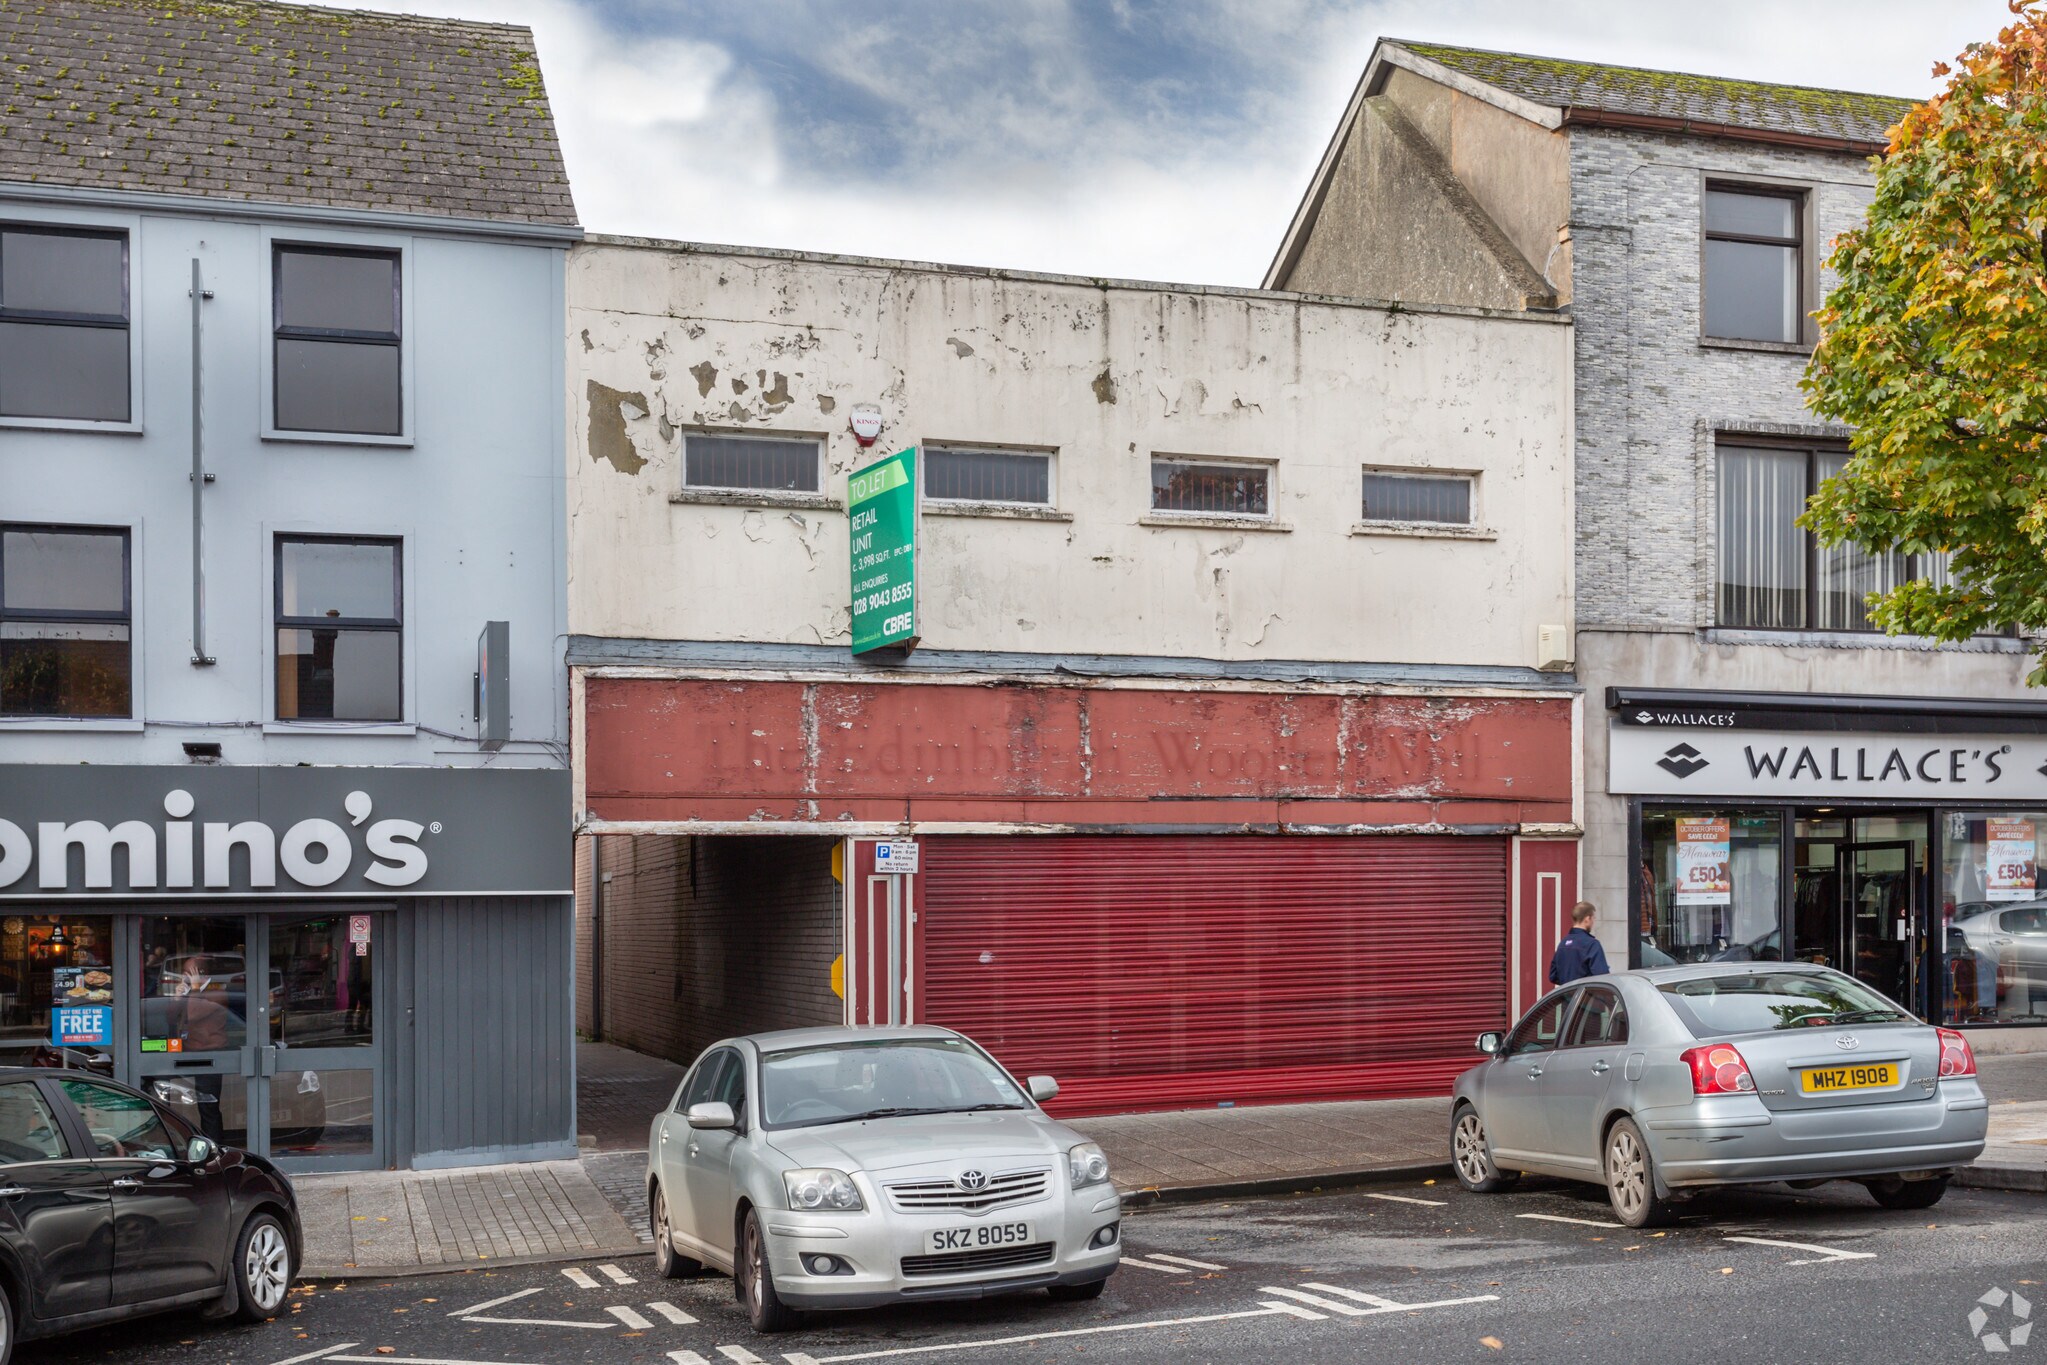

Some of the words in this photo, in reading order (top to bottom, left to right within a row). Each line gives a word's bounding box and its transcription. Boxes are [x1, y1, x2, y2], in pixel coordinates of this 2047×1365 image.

[851, 479, 866, 501] TO
[869, 469, 887, 493] LET
[852, 507, 878, 532] RETAIL
[852, 532, 873, 555] UNIT
[858, 553, 875, 571] 3,998
[853, 582, 861, 594] ALL
[861, 573, 888, 590] ENQUIRIES
[853, 597, 867, 616] 028
[869, 589, 890, 611] 9043
[891, 581, 912, 603] 8555
[883, 611, 912, 636] CBRE
[1680, 825, 1705, 833] OCTOBER
[1705, 825, 1726, 833] OFFERS
[1990, 824, 2012, 832] OCTOBER
[1679, 844, 1727, 859] Menswear
[1988, 843, 2032, 858] Menswear
[1688, 866, 1717, 883] £50
[1997, 863, 2023, 880] £50
[60, 1014, 103, 1034] FREE
[1812, 1070, 1848, 1089] MHZ
[1850, 1067, 1889, 1086] 1908
[933, 1228, 972, 1250] SKZ
[977, 1222, 1028, 1245] 8059
